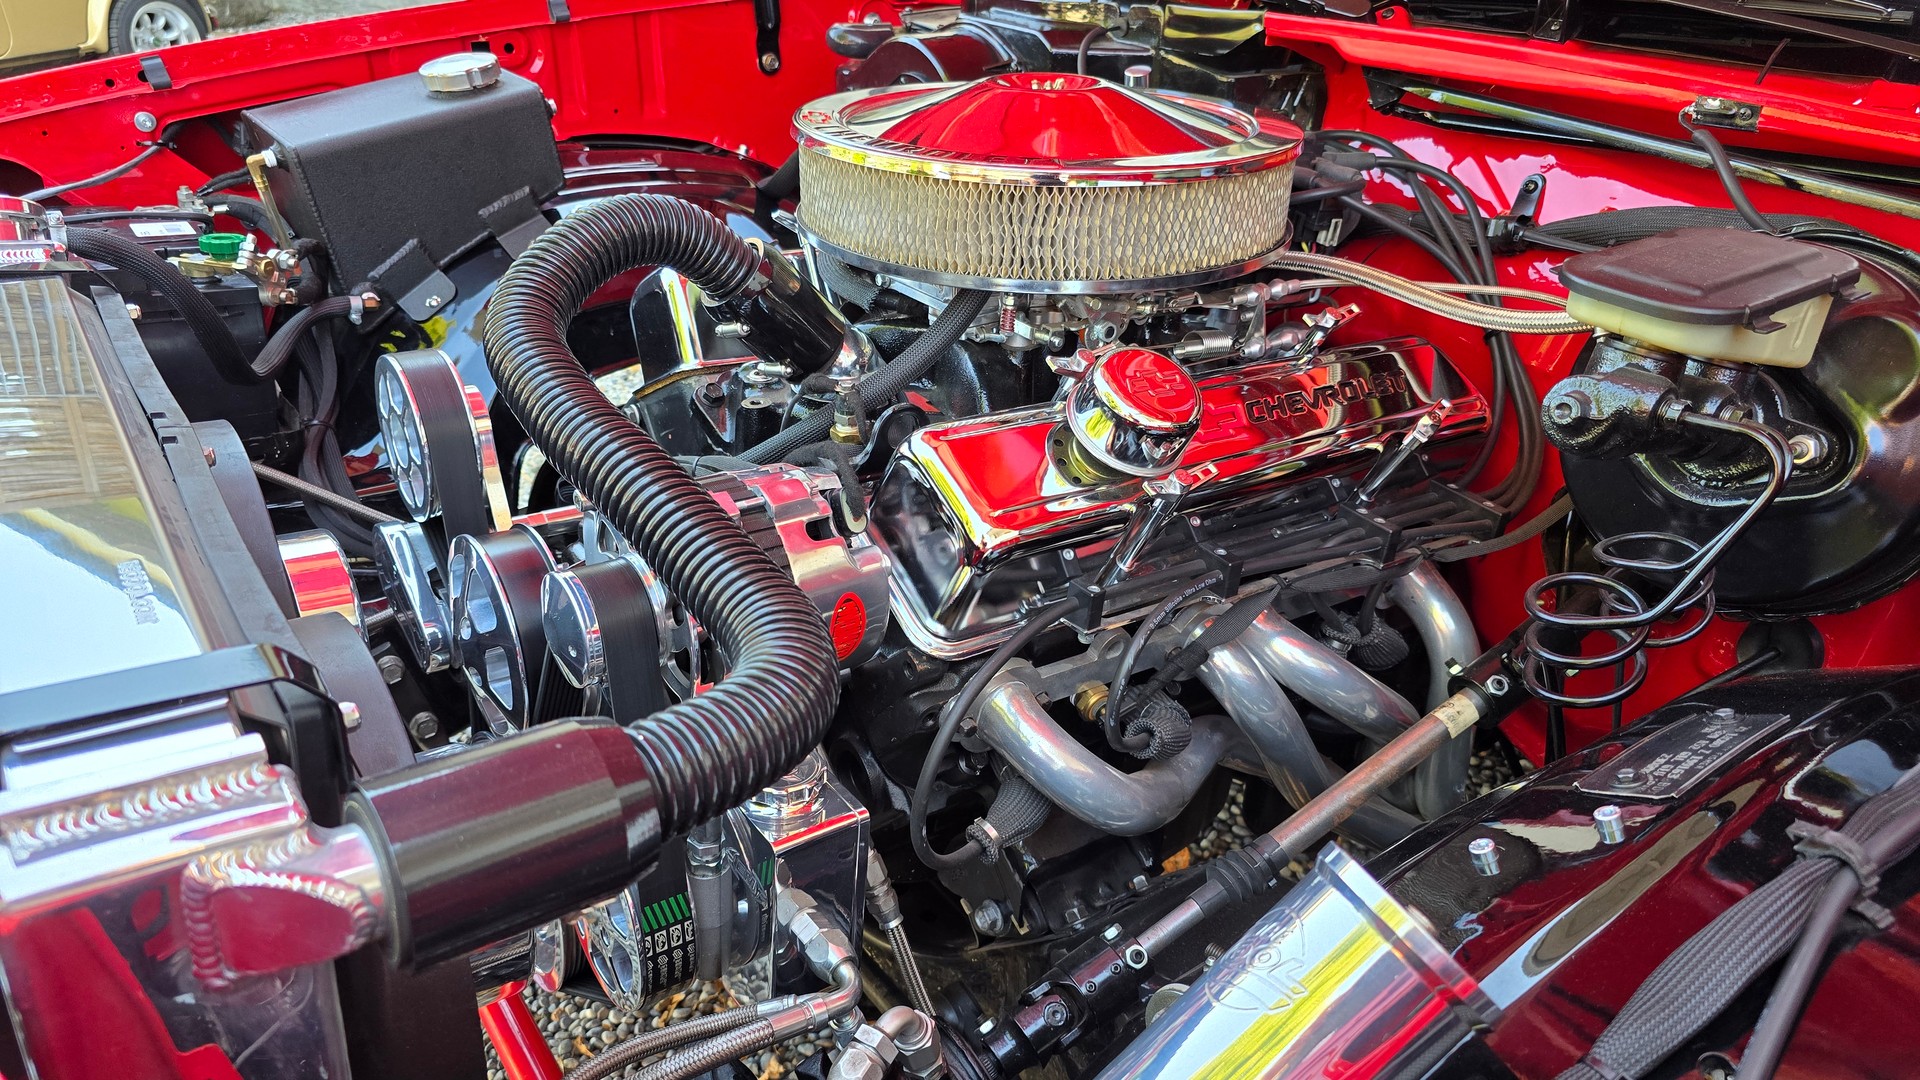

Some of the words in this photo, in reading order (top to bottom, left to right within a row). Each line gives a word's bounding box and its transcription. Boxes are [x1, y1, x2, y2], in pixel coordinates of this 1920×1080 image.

[1245, 368, 1406, 424] CHEVROLET
[1194, 582, 1205, 591] Low
[1205, 577, 1217, 586] Ohm
